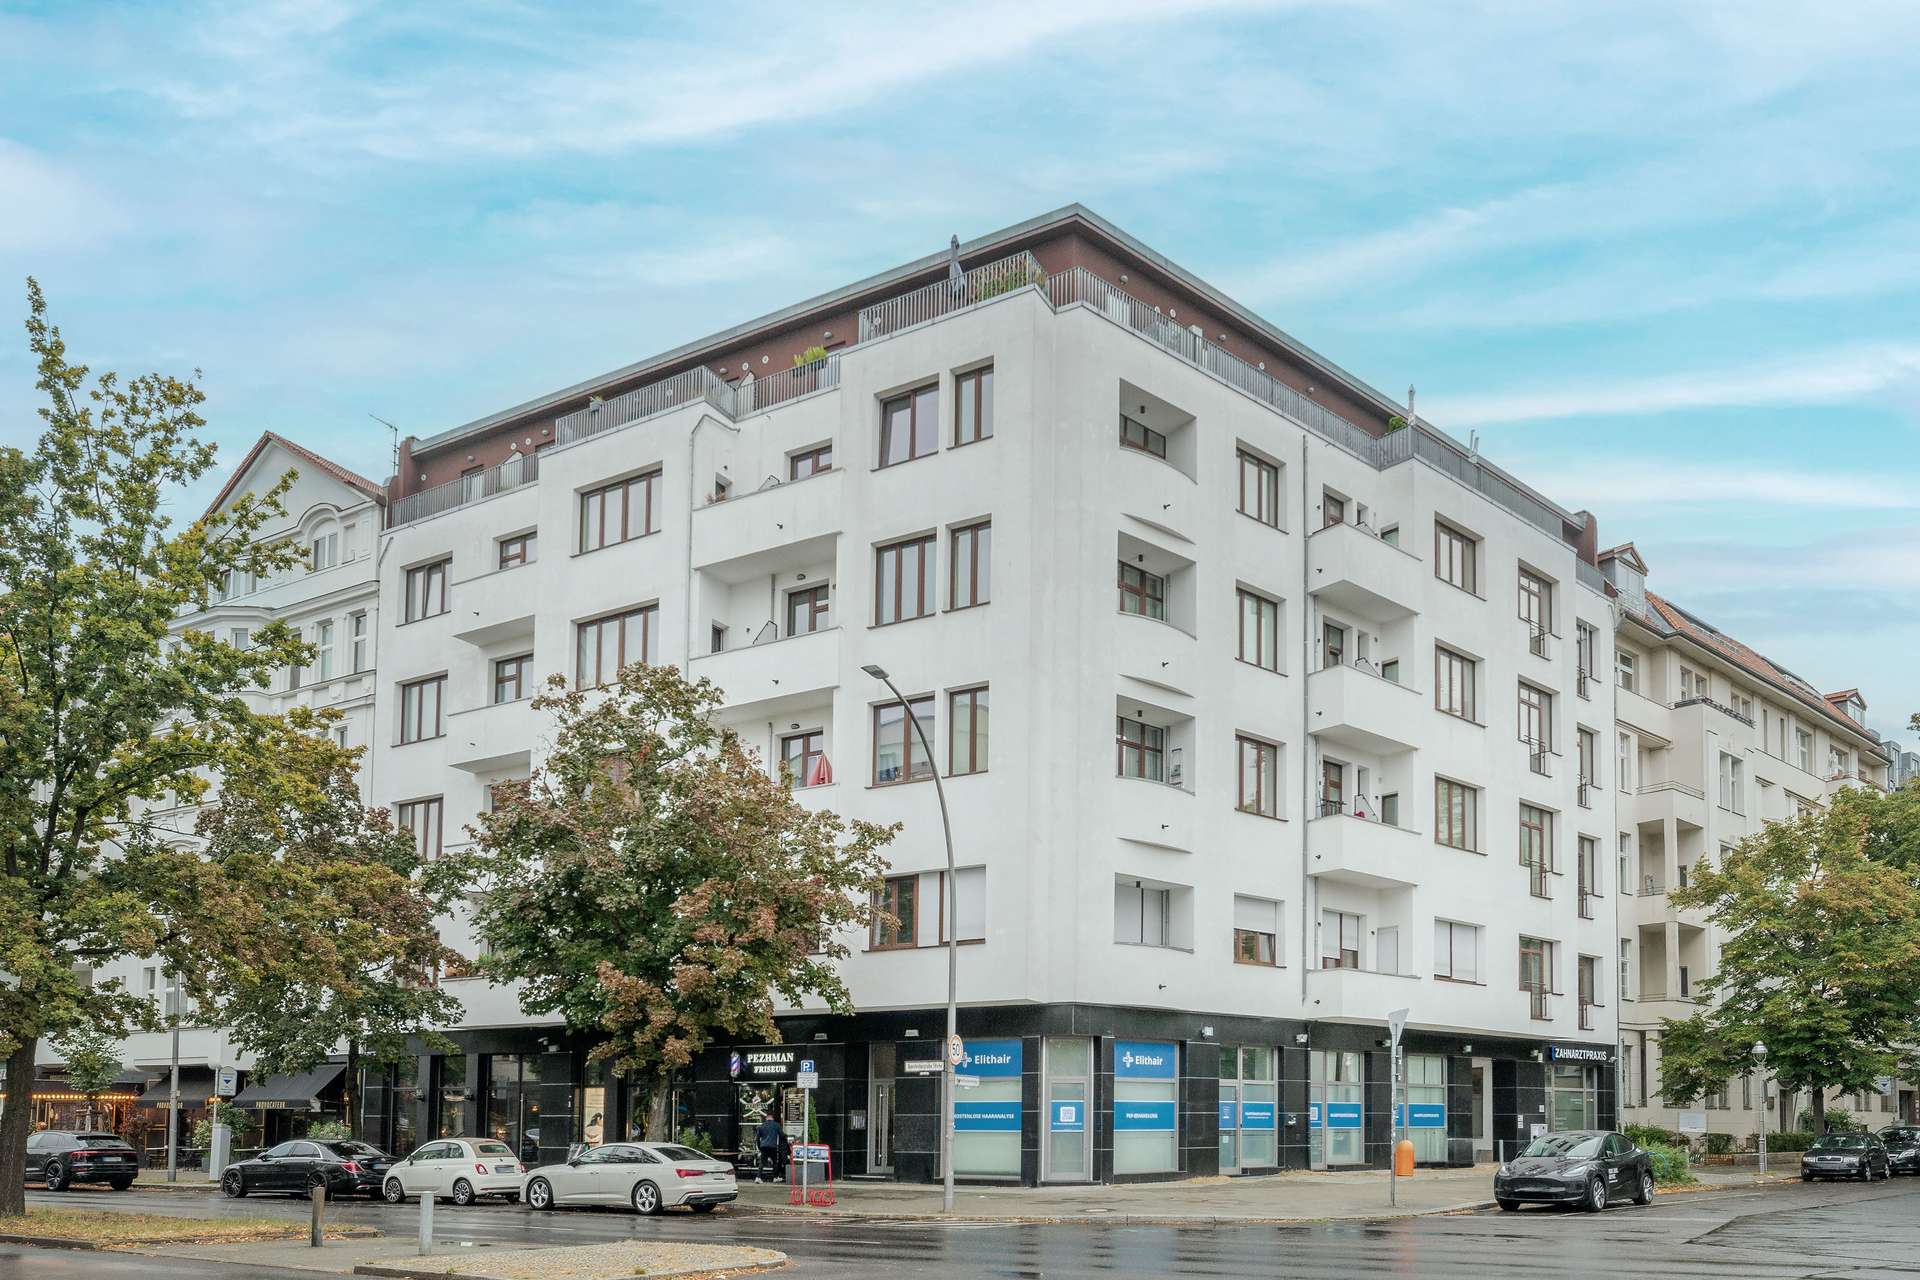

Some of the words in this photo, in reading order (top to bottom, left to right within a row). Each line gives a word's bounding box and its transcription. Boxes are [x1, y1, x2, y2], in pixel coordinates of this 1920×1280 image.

[952, 1043, 960, 1056] 50
[1555, 1048, 1607, 1060] ZAHNARZTPRAXIS
[747, 1052, 794, 1063] PEZHMAN
[974, 1055, 1011, 1065] Elithair
[1135, 1056, 1163, 1065] Elithair
[754, 1065, 787, 1073] FRISEUR
[803, 1063, 810, 1071] P
